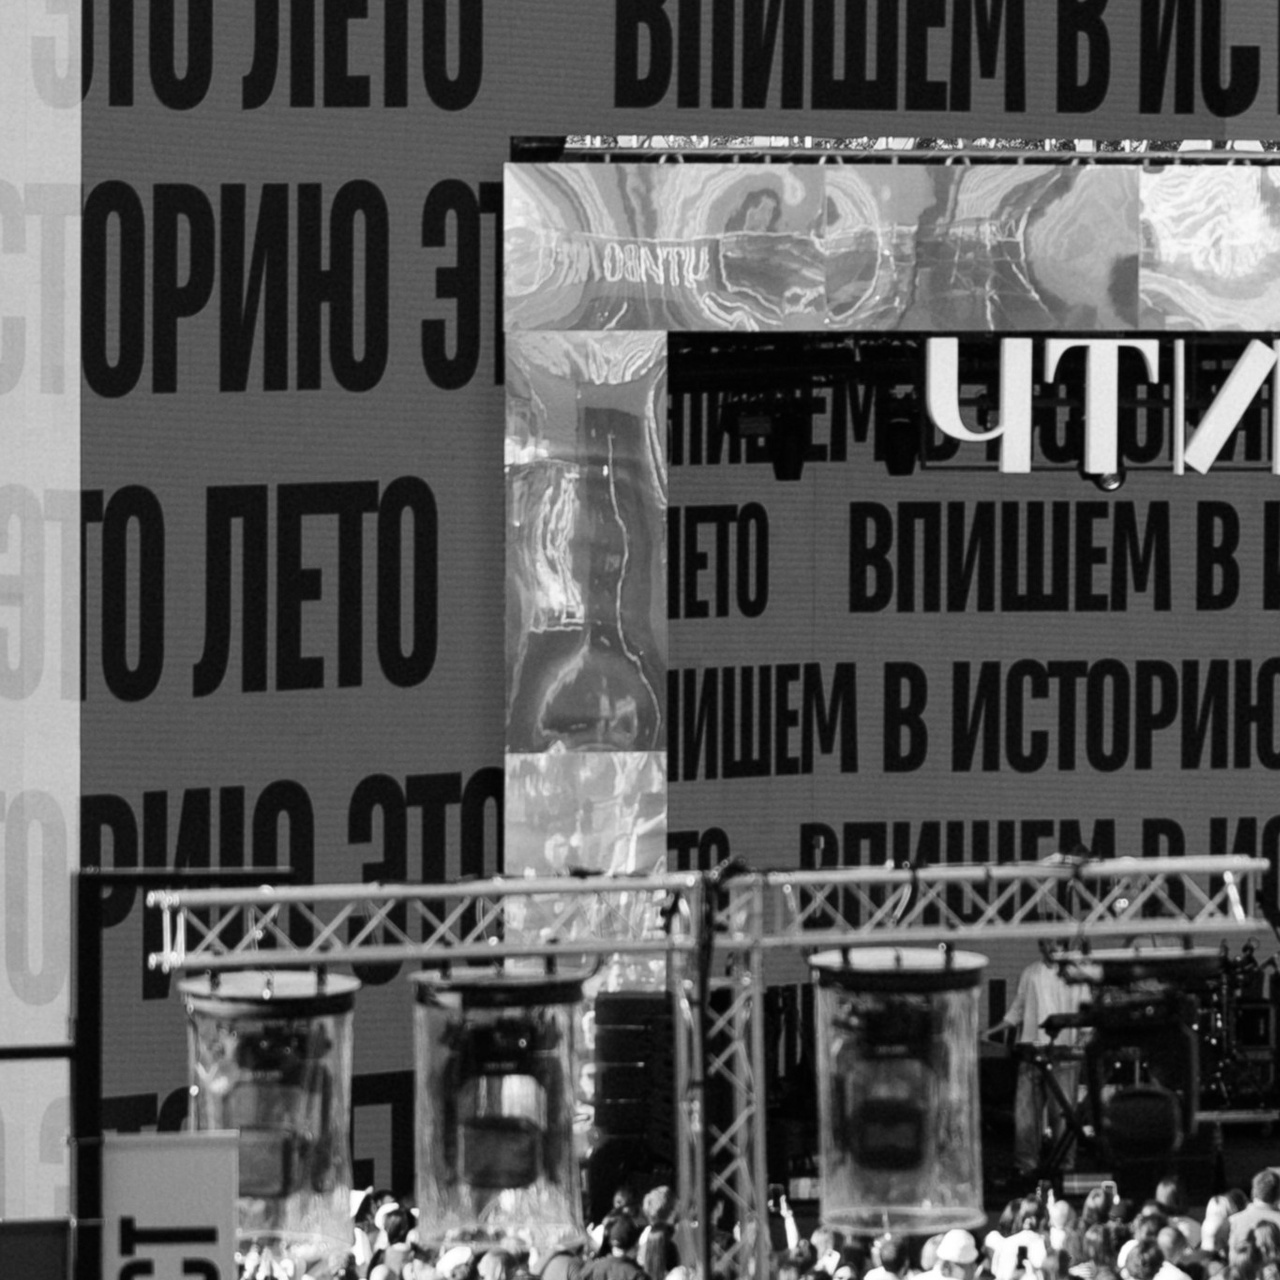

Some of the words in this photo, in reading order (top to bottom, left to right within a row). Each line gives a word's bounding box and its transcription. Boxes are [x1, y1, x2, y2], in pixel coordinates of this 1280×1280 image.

[192, 476, 439, 698] ЛЕТО
[667, 502, 769, 619] ЕТО
[849, 500, 1171, 613] ВПИШЕМ
[1200, 500, 1240, 612] В
[883, 662, 928, 773] В
